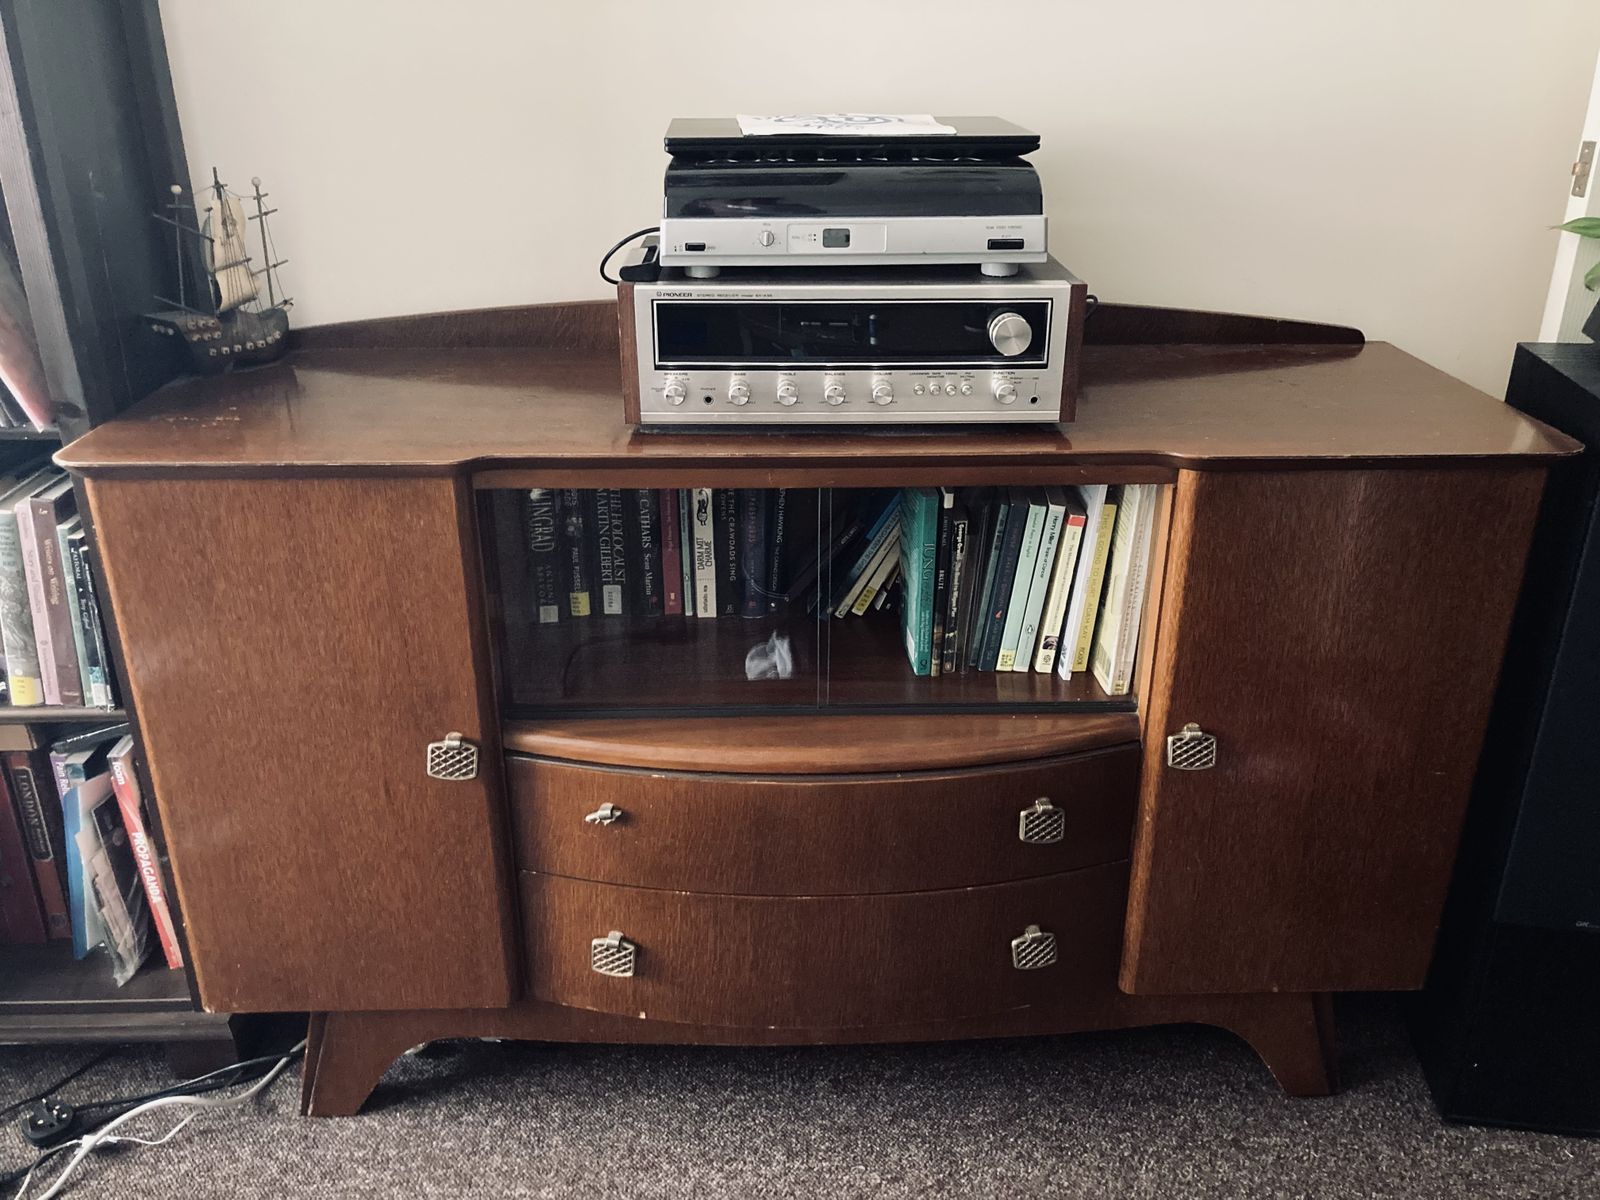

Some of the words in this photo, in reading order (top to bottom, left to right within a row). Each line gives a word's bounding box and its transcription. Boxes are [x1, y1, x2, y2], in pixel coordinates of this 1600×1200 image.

[610, 489, 623, 512] THE
[639, 498, 652, 548] CATHARS
[776, 510, 785, 543] HAWKING
[1050, 515, 1060, 530] Henry
[1102, 512, 1111, 530] THIS
[728, 517, 737, 560] CRAWDADS
[955, 523, 965, 542] George
[1048, 531, 1056, 544] Miller
[43, 538, 54, 565] Writers
[610, 512, 626, 584] HOLOCAUST
[695, 537, 704, 551] MIT
[704, 540, 713, 567] CHARME
[955, 543, 964, 560] Orwell
[1094, 540, 1107, 565] GOING
[26, 550, 35, 566] Story
[31, 568, 40, 583] and
[47, 565, 54, 575] on
[600, 536, 613, 584] GILBERT
[643, 553, 653, 570] Sean
[696, 551, 705, 571] DARM
[922, 542, 936, 580] JUNG
[729, 563, 737, 581] SING
[937, 570, 945, 590] BRUTE
[1094, 567, 1103, 576] TO
[50, 577, 60, 606] Writing
[645, 571, 654, 595] Martin
[1088, 578, 1100, 597] HURT
[1084, 603, 1097, 623] ADAM
[1081, 625, 1092, 639] KAY
[57, 761, 68, 776] Pain
[112, 760, 126, 785] foam
[19, 774, 38, 826] LONDON
[131, 831, 162, 904] PROPAGANDA
